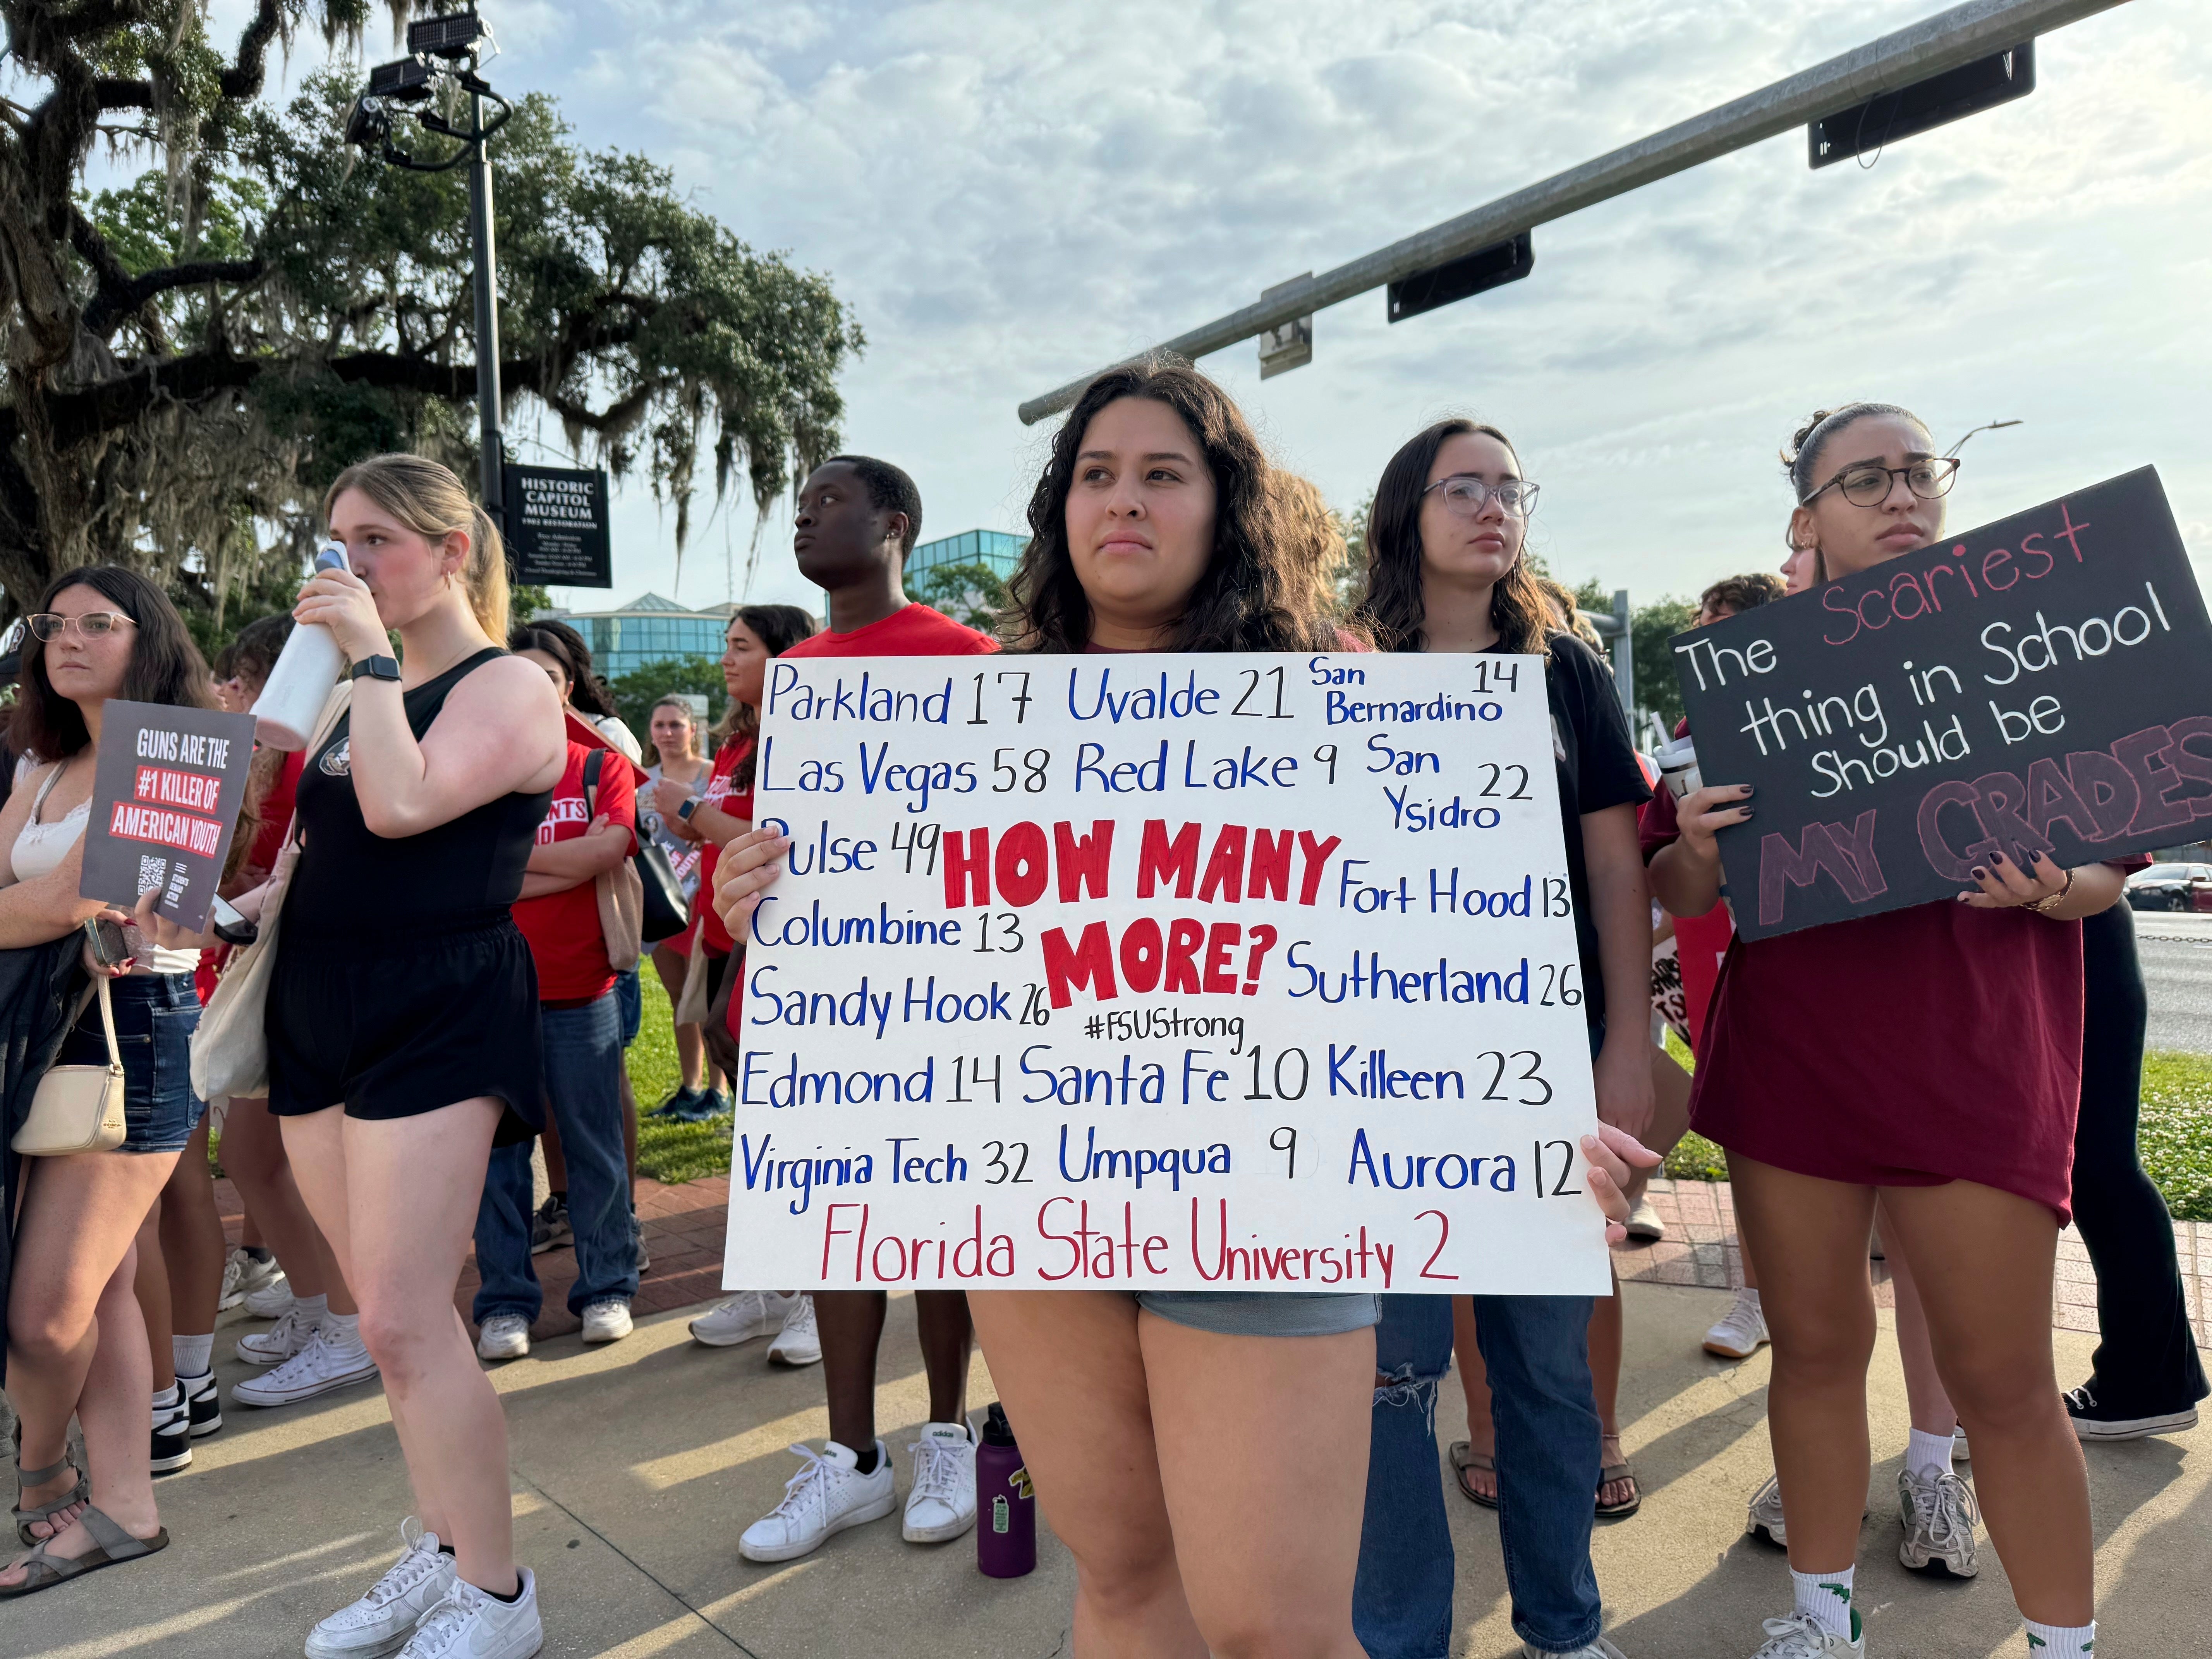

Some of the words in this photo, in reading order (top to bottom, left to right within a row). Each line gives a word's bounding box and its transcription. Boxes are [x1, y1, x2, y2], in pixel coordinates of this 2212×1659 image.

[521, 477, 594, 495] HISTORIC
[524, 503, 592, 520] MUSEUM
[525, 490, 591, 507] CAPITOL
[542, 519, 598, 529] RESTORATION
[1675, 638, 1777, 691] The
[1823, 504, 2090, 645] Scariest
[770, 664, 952, 724] Parkland
[967, 673, 1032, 725] 17
[1069, 668, 1219, 724] Uvalde
[1231, 666, 1294, 718] 21
[1309, 656, 1365, 685] San
[1472, 661, 1517, 693] 14
[1740, 684, 1887, 756] thing
[1903, 661, 1962, 706] in
[1980, 581, 2171, 685] School
[1327, 691, 1502, 725] Bernardino
[1989, 696, 2065, 745] be
[137, 728, 178, 761] GUNS
[180, 734, 206, 765] ARE
[207, 737, 230, 769] THE
[763, 736, 843, 792] Las
[860, 742, 977, 813] Vegas
[993, 749, 1050, 793] 58
[1076, 740, 1168, 792] Red
[1185, 740, 1298, 790] Lake
[1314, 745, 1337, 784] 9
[1367, 733, 1439, 775] San
[1478, 763, 1532, 800] 22
[138, 769, 158, 799] #1
[160, 772, 204, 807] KILLER
[203, 779, 220, 810] OF
[545, 801, 586, 821] NTS
[1383, 785, 1501, 832] Ysidro
[112, 805, 190, 846] AMERICAN
[189, 818, 221, 855] YOUTH
[1759, 808, 1888, 926] MY
[1917, 715, 2212, 882] GRADES
[891, 822, 940, 876] 49
[943, 820, 1115, 909] HOW
[1137, 819, 1341, 906] MANY
[1340, 860, 1416, 913] Fort
[1430, 867, 1531, 917] Hood
[1543, 878, 1570, 917] 13
[752, 896, 961, 946] Columbine
[973, 913, 1023, 952] 13
[1041, 917, 1277, 1009] MORE?
[1288, 941, 1528, 1004] Sutherland
[1539, 964, 1582, 1006] 26
[751, 965, 891, 1039] Sandy
[904, 976, 1012, 1023] Hook
[1020, 984, 1049, 1025] 26
[1084, 1008, 1243, 1055] #FSUStrong
[742, 1051, 933, 1108] Edmond
[946, 1055, 1000, 1103] 14
[1020, 1045, 1164, 1105] Santa
[1183, 1049, 1229, 1104] Fe
[1244, 1045, 1309, 1100] 10
[1329, 1044, 1463, 1100] Killeen
[1477, 1051, 1552, 1105] 23
[741, 1134, 872, 1215] Virginia
[885, 1138, 967, 1183] Tech
[982, 1141, 1033, 1184] 32
[1060, 1124, 1230, 1191] Umpqua
[1270, 1127, 1296, 1178] 9
[1348, 1128, 1515, 1192] Aurora
[1535, 1140, 1582, 1198] 12
[822, 1204, 1014, 1282] Florida
[1038, 1197, 1168, 1280] State
[1192, 1197, 1393, 1288] University
[1414, 1211, 1458, 1279] 2
